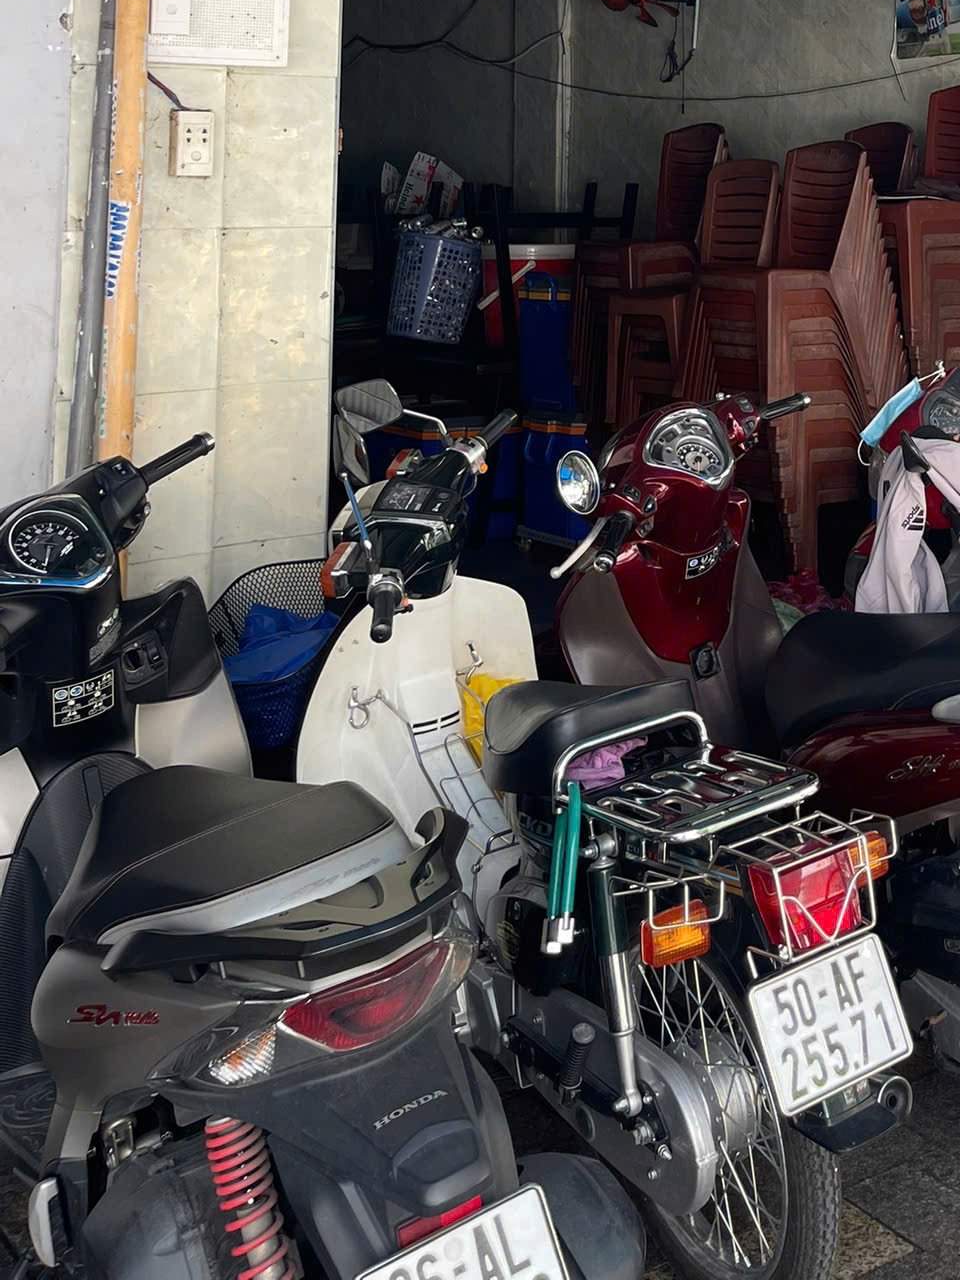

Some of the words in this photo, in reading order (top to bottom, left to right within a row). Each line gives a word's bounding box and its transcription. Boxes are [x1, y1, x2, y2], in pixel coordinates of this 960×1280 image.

[772, 951, 865, 1037] 50-AF
[781, 1001, 896, 1101] 255.71
[373, 1090, 448, 1131] HONDA
